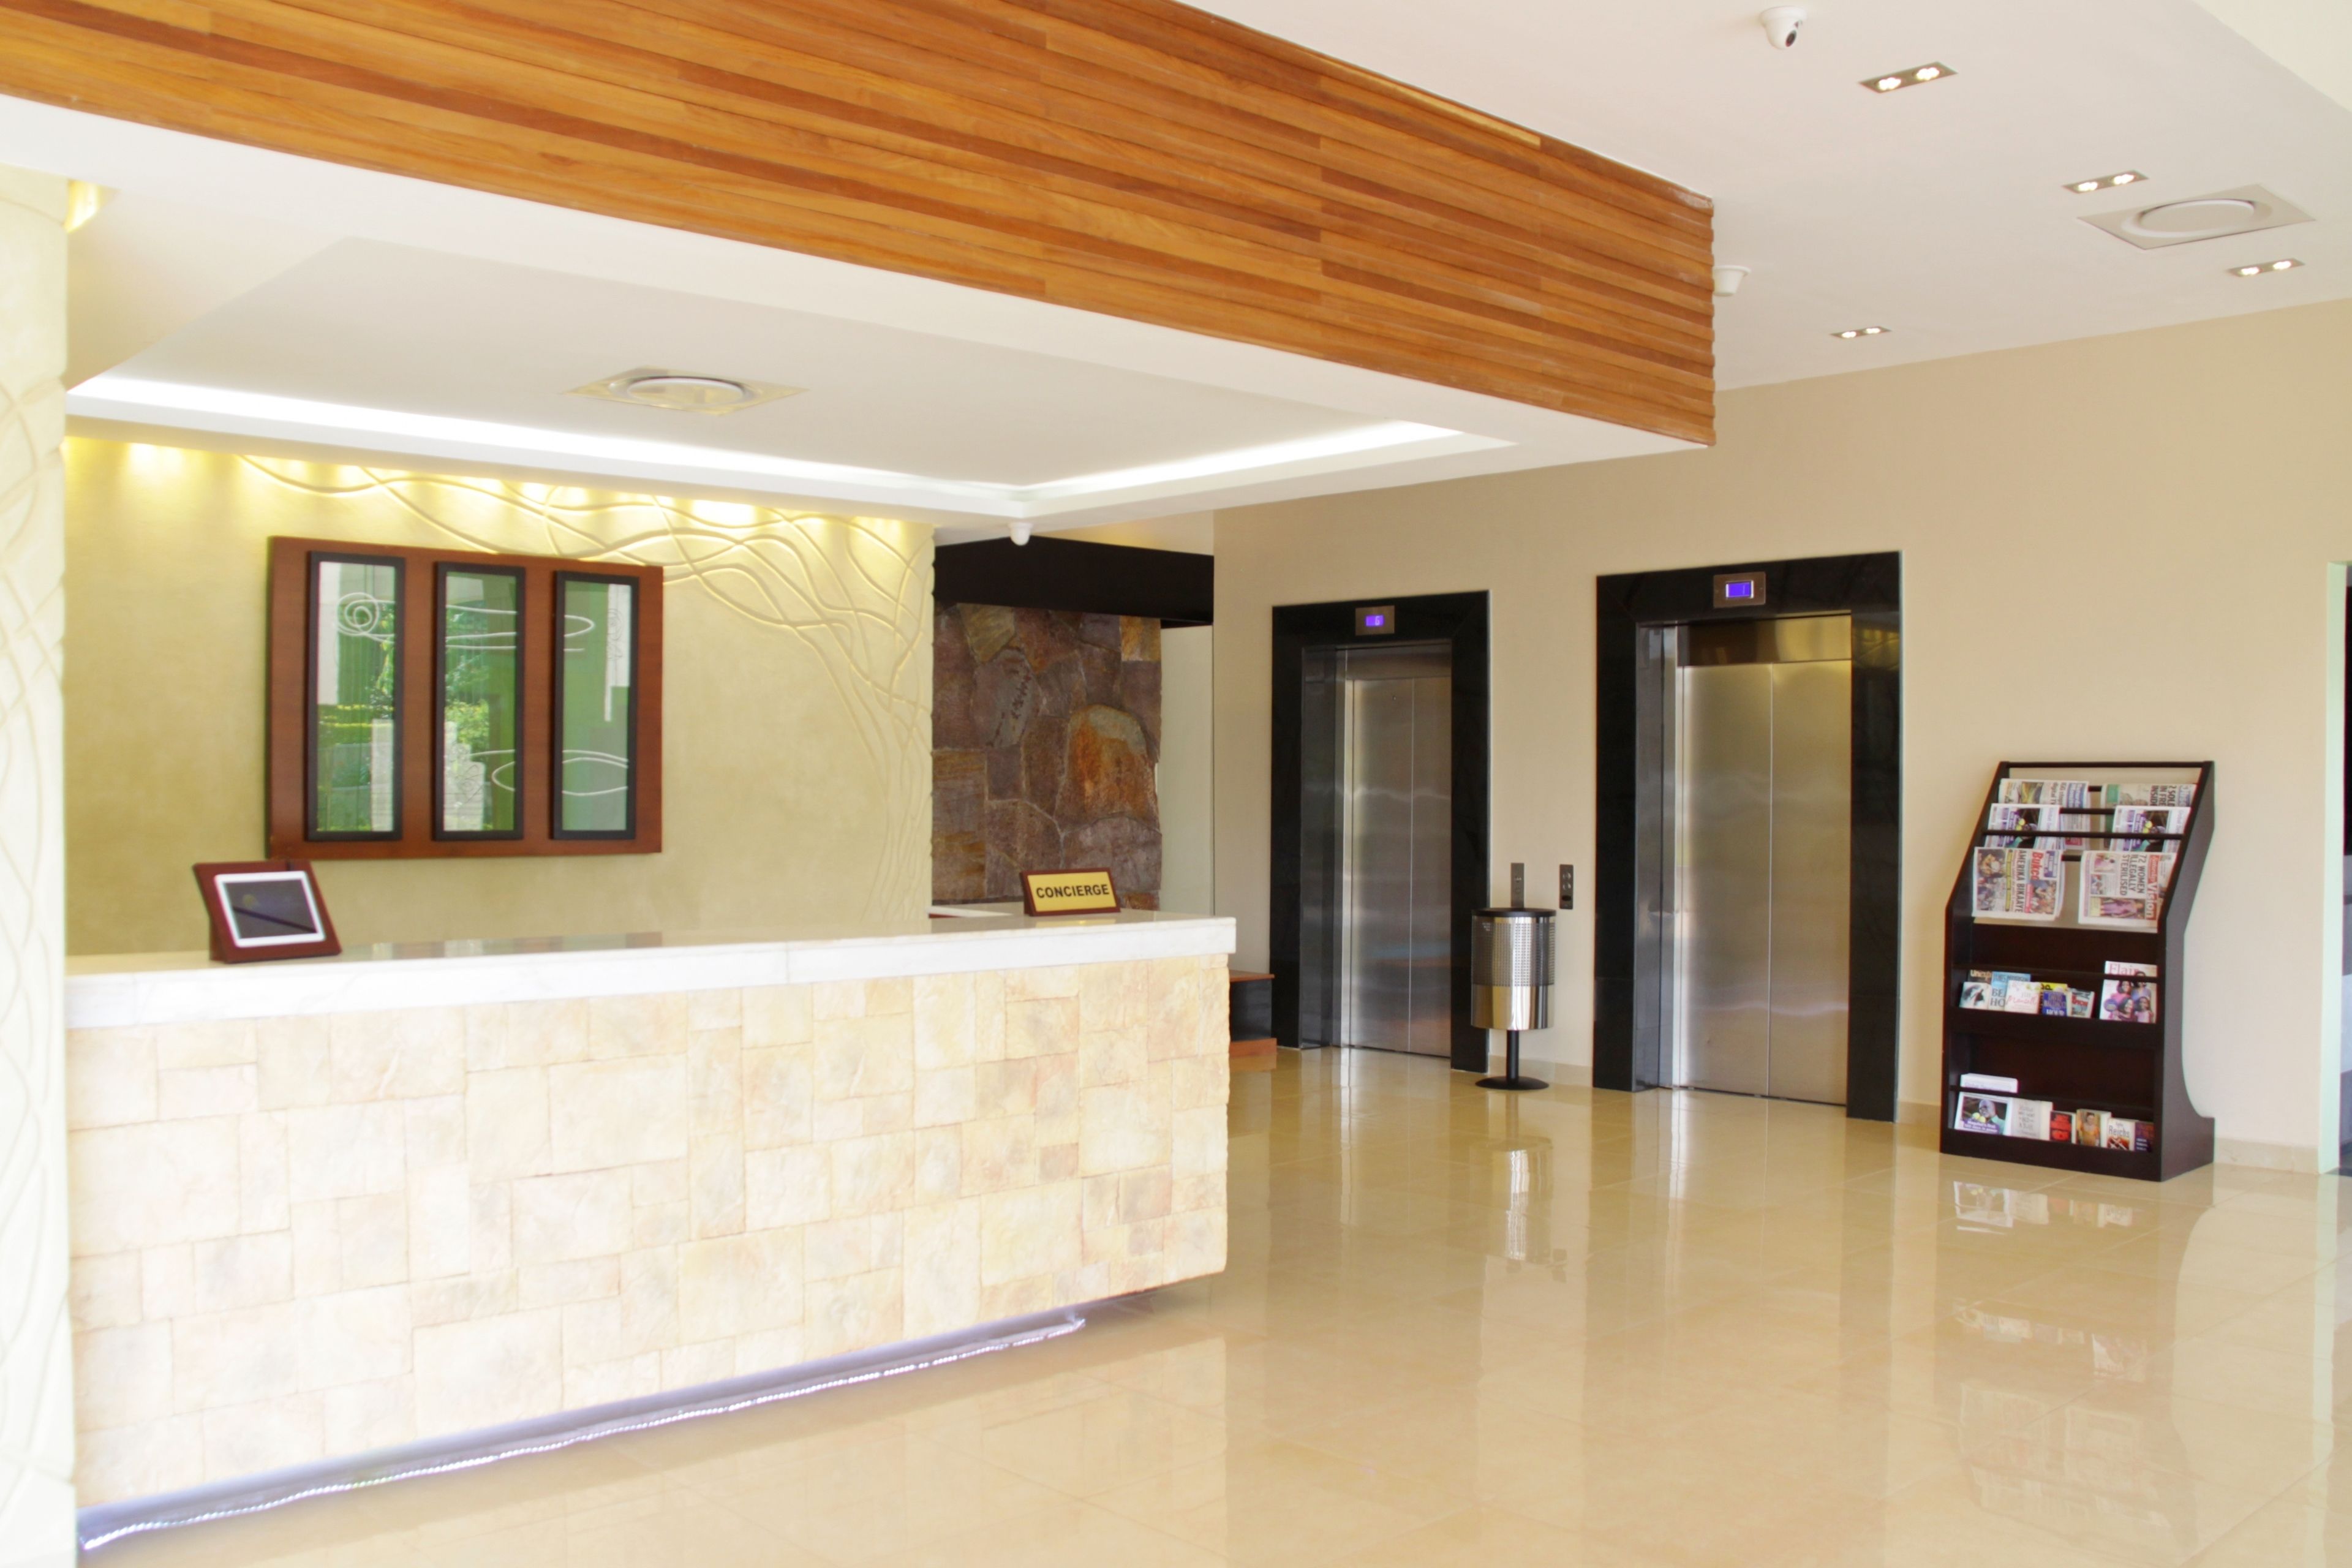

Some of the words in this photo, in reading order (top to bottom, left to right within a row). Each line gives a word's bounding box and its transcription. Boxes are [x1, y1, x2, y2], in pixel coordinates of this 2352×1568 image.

[2016, 850, 2027, 881] AMERIKA
[2128, 854, 2138, 892] ILLEGALLY
[2138, 854, 2147, 863] 72
[2120, 854, 2129, 895] STERILISED
[2137, 865, 2146, 894] WOMEN
[1036, 884, 1110, 899] CONCIERGE
[2146, 882, 2157, 918] Vision
[2108, 1126, 2130, 1138] Reichs
